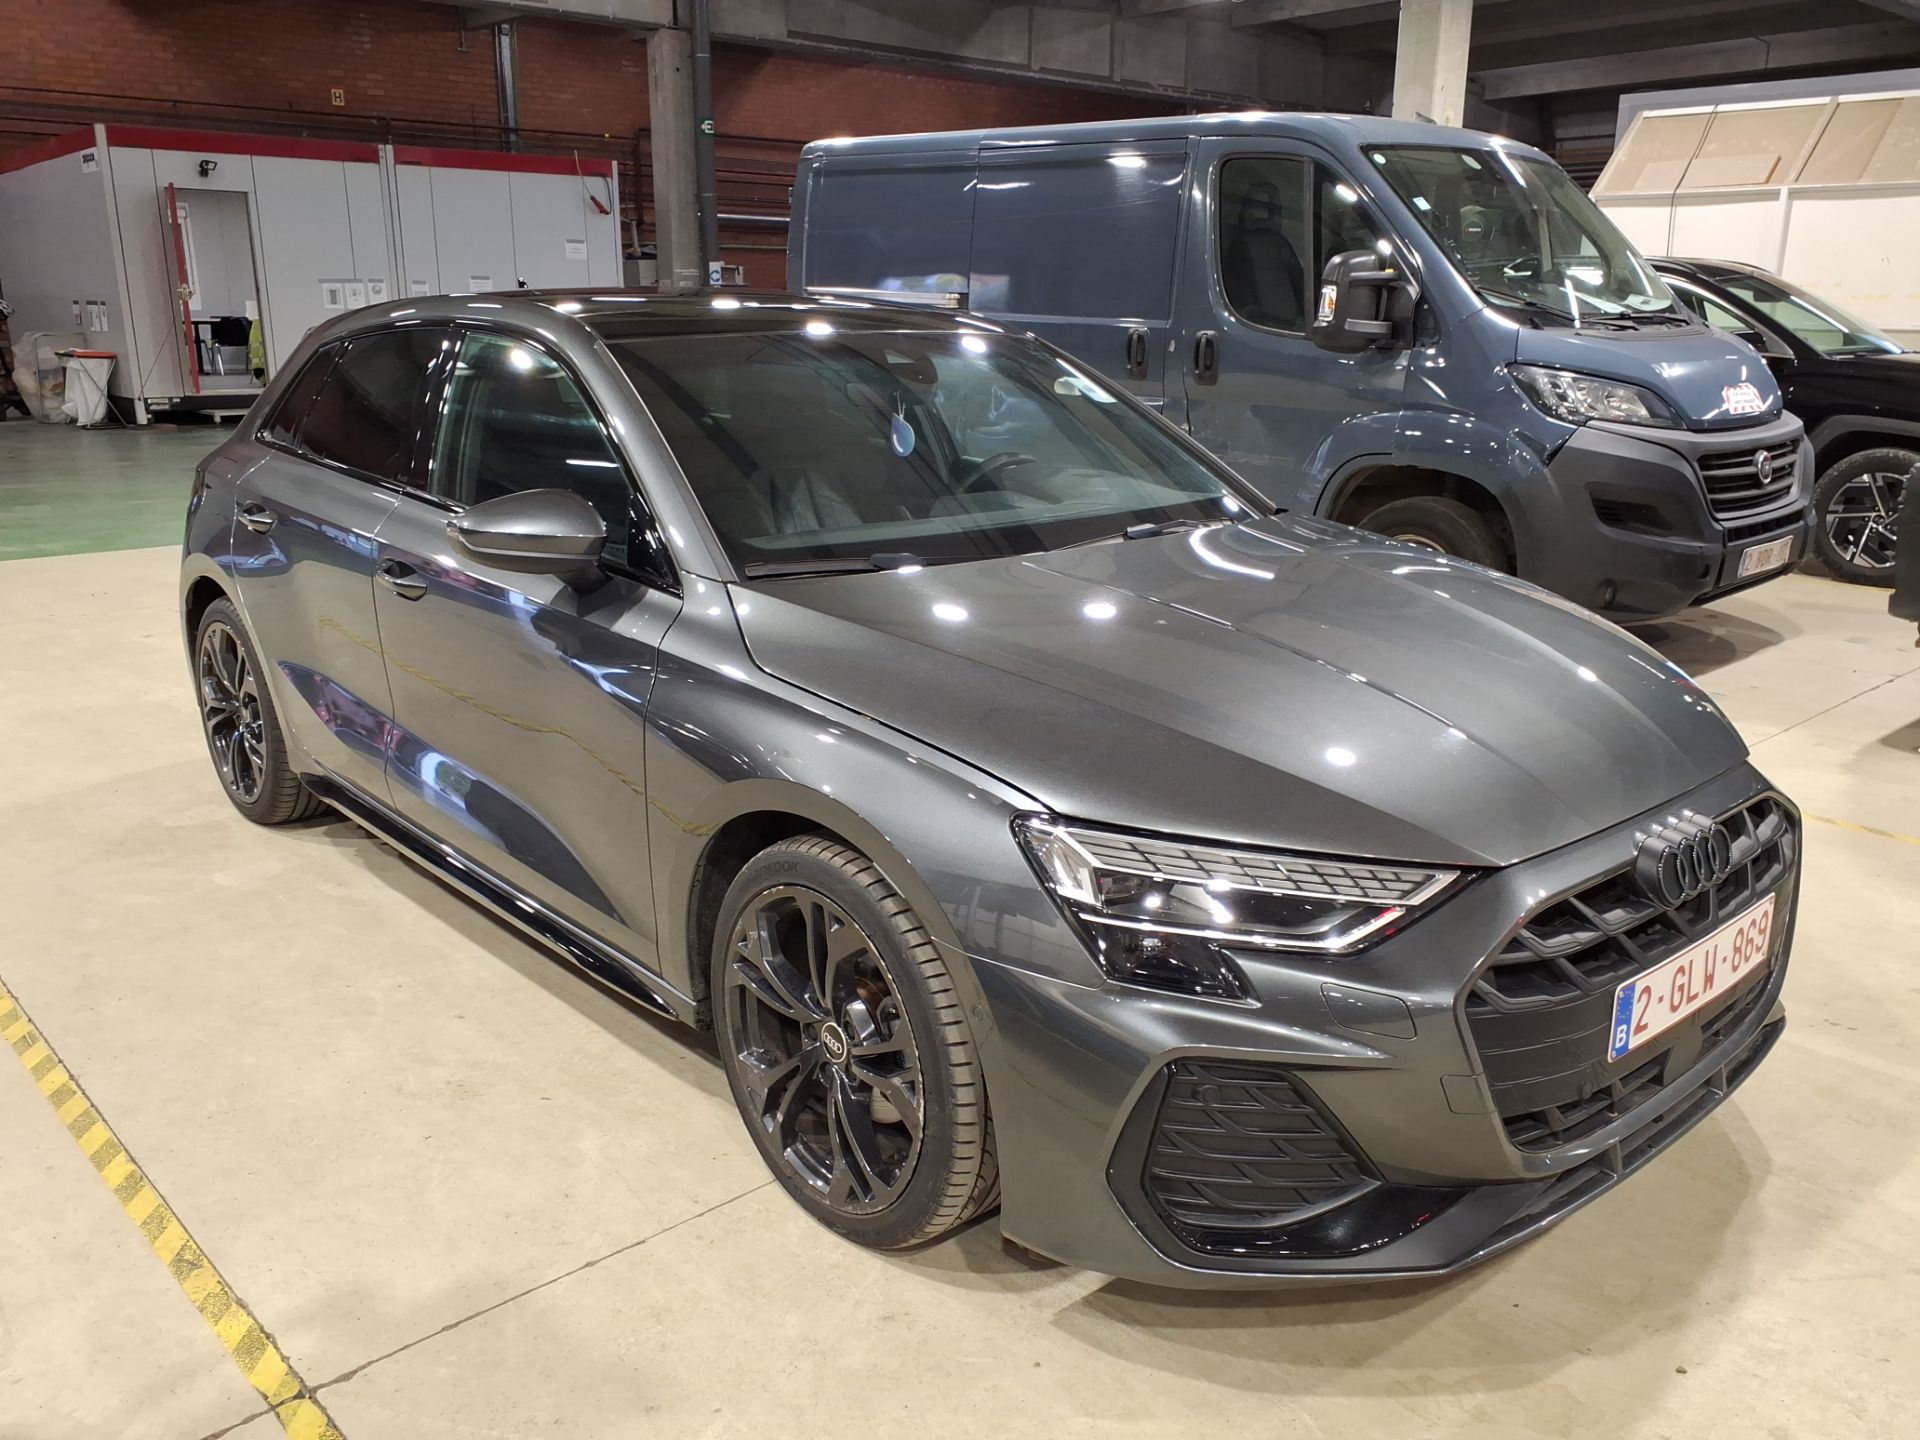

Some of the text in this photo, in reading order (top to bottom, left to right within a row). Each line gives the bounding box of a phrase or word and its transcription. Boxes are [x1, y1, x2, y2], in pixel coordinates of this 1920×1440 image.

[333, 91, 343, 103] H
[1632, 909, 1770, 1038] 2-GLW-869
[1614, 1023, 1627, 1049] B
